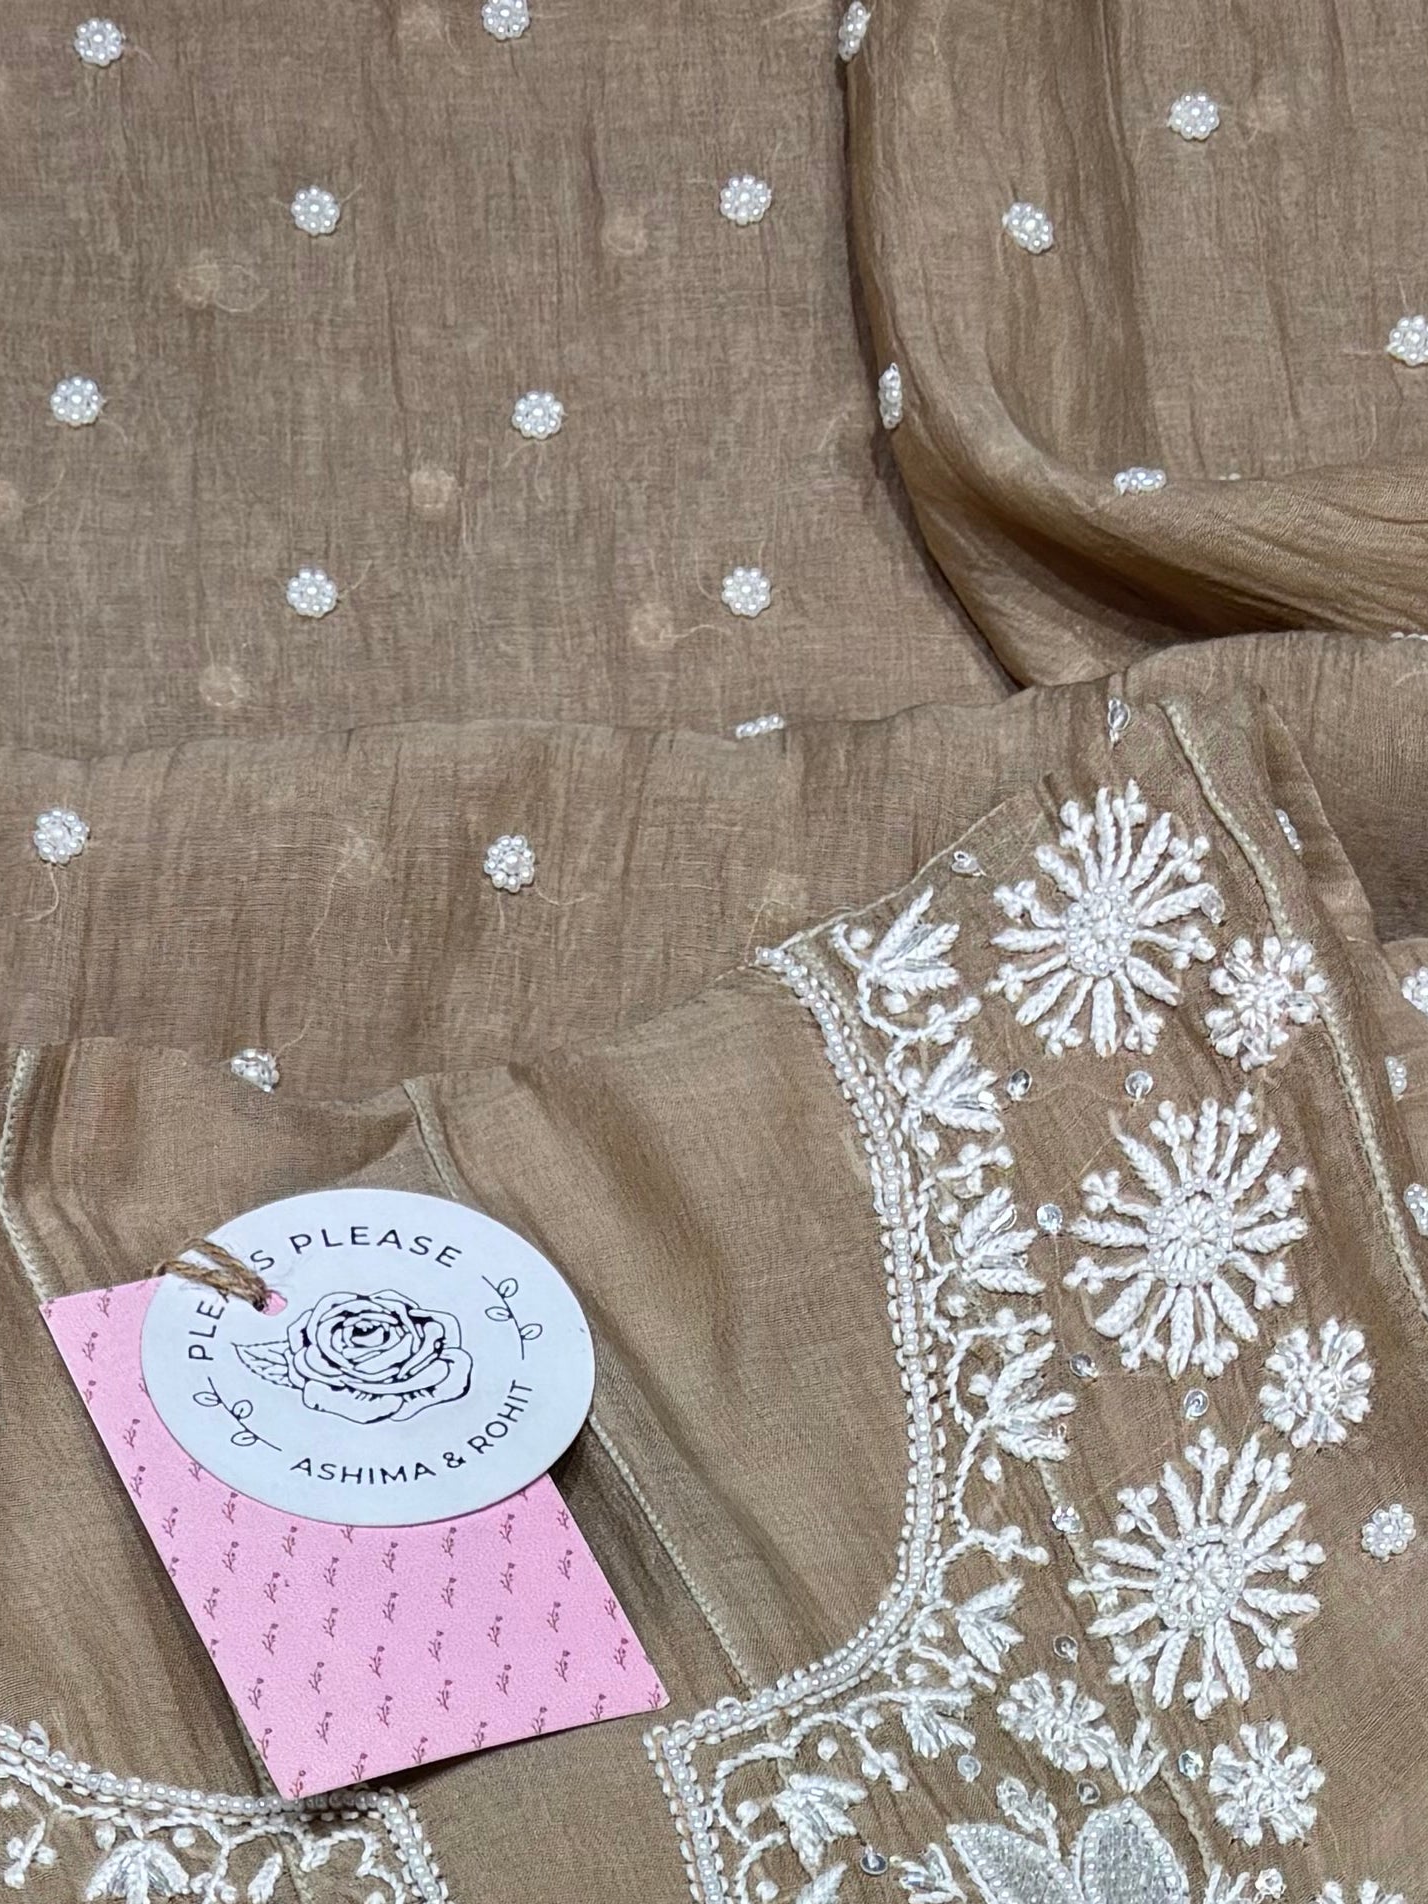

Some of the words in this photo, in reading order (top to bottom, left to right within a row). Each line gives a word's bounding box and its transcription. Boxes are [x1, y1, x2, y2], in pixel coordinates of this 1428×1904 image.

[188, 1250, 275, 1361] PLES
[289, 1226, 462, 1268] PLEASE
[290, 1457, 437, 1485] ASHIMA
[442, 1451, 466, 1469] &
[467, 1379, 533, 1454] ROHIT
